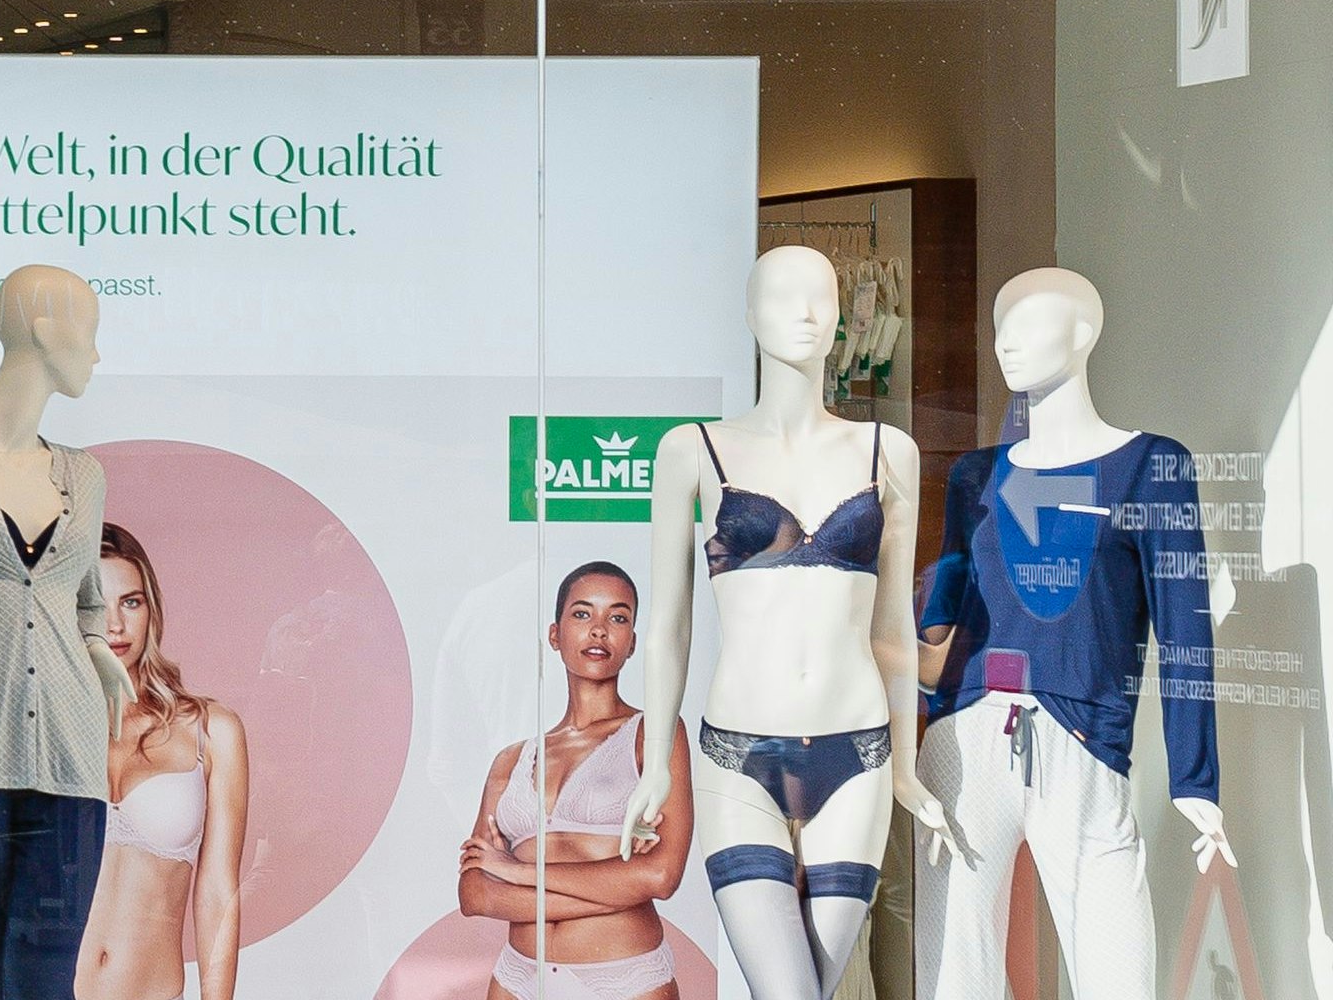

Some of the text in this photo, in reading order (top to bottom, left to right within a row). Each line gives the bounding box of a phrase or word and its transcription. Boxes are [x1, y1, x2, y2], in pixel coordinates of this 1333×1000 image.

[109, 133, 148, 176] in
[161, 131, 242, 177] der
[252, 131, 443, 184] Qualität
[228, 191, 358, 237] steht.
[85, 275, 163, 302] passt.
[535, 458, 657, 489] PALME
